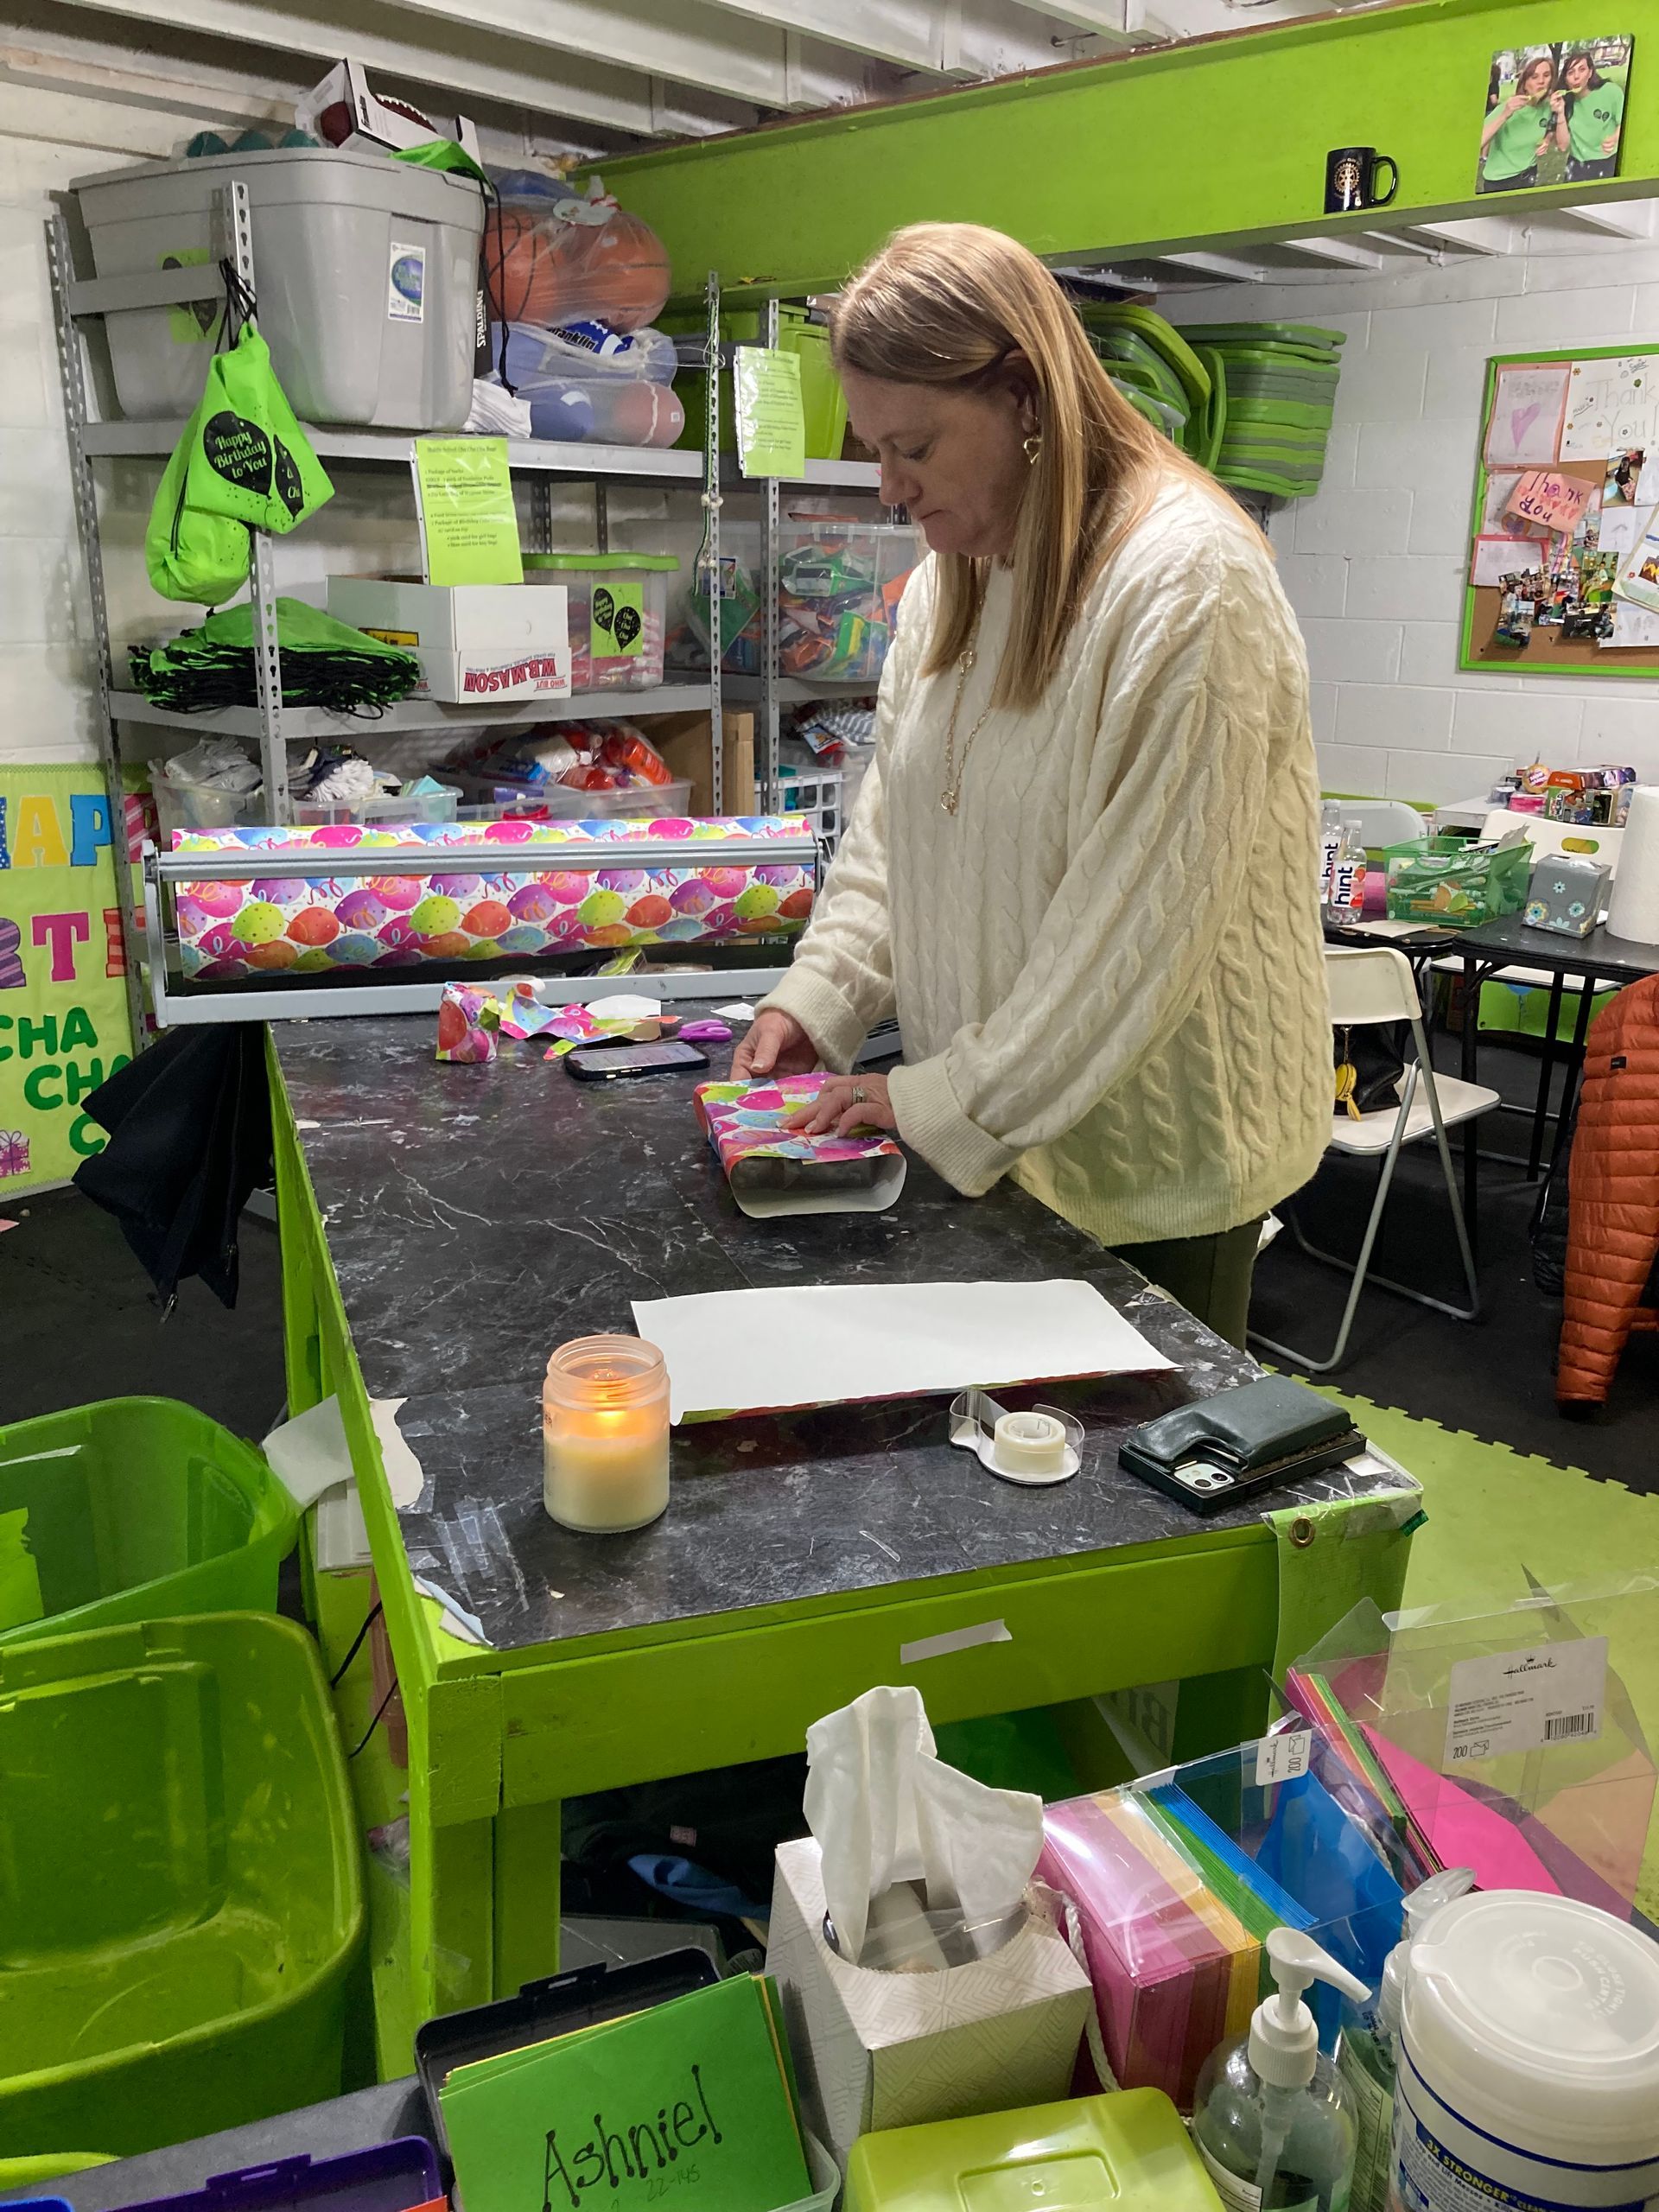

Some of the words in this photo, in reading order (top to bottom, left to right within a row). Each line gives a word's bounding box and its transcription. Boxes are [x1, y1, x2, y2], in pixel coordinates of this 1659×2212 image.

[476, 289, 487, 348] SPALDING
[214, 432, 252, 450] Happy
[214, 441, 266, 468] Birthday
[232, 467, 243, 479] to
[243, 457, 267, 473] You
[1334, 867, 1353, 905] hint
[1503, 1656, 1557, 1680] Hallmark
[1287, 1757, 1301, 1773] 200
[1452, 1745, 1468, 1759] 200
[1572, 1948, 1606, 1975] PUSH
[543, 2064, 722, 2212] Ashniel
[1427, 2139, 1440, 2158] 3X
[1443, 2155, 1510, 2202] STRONGER
